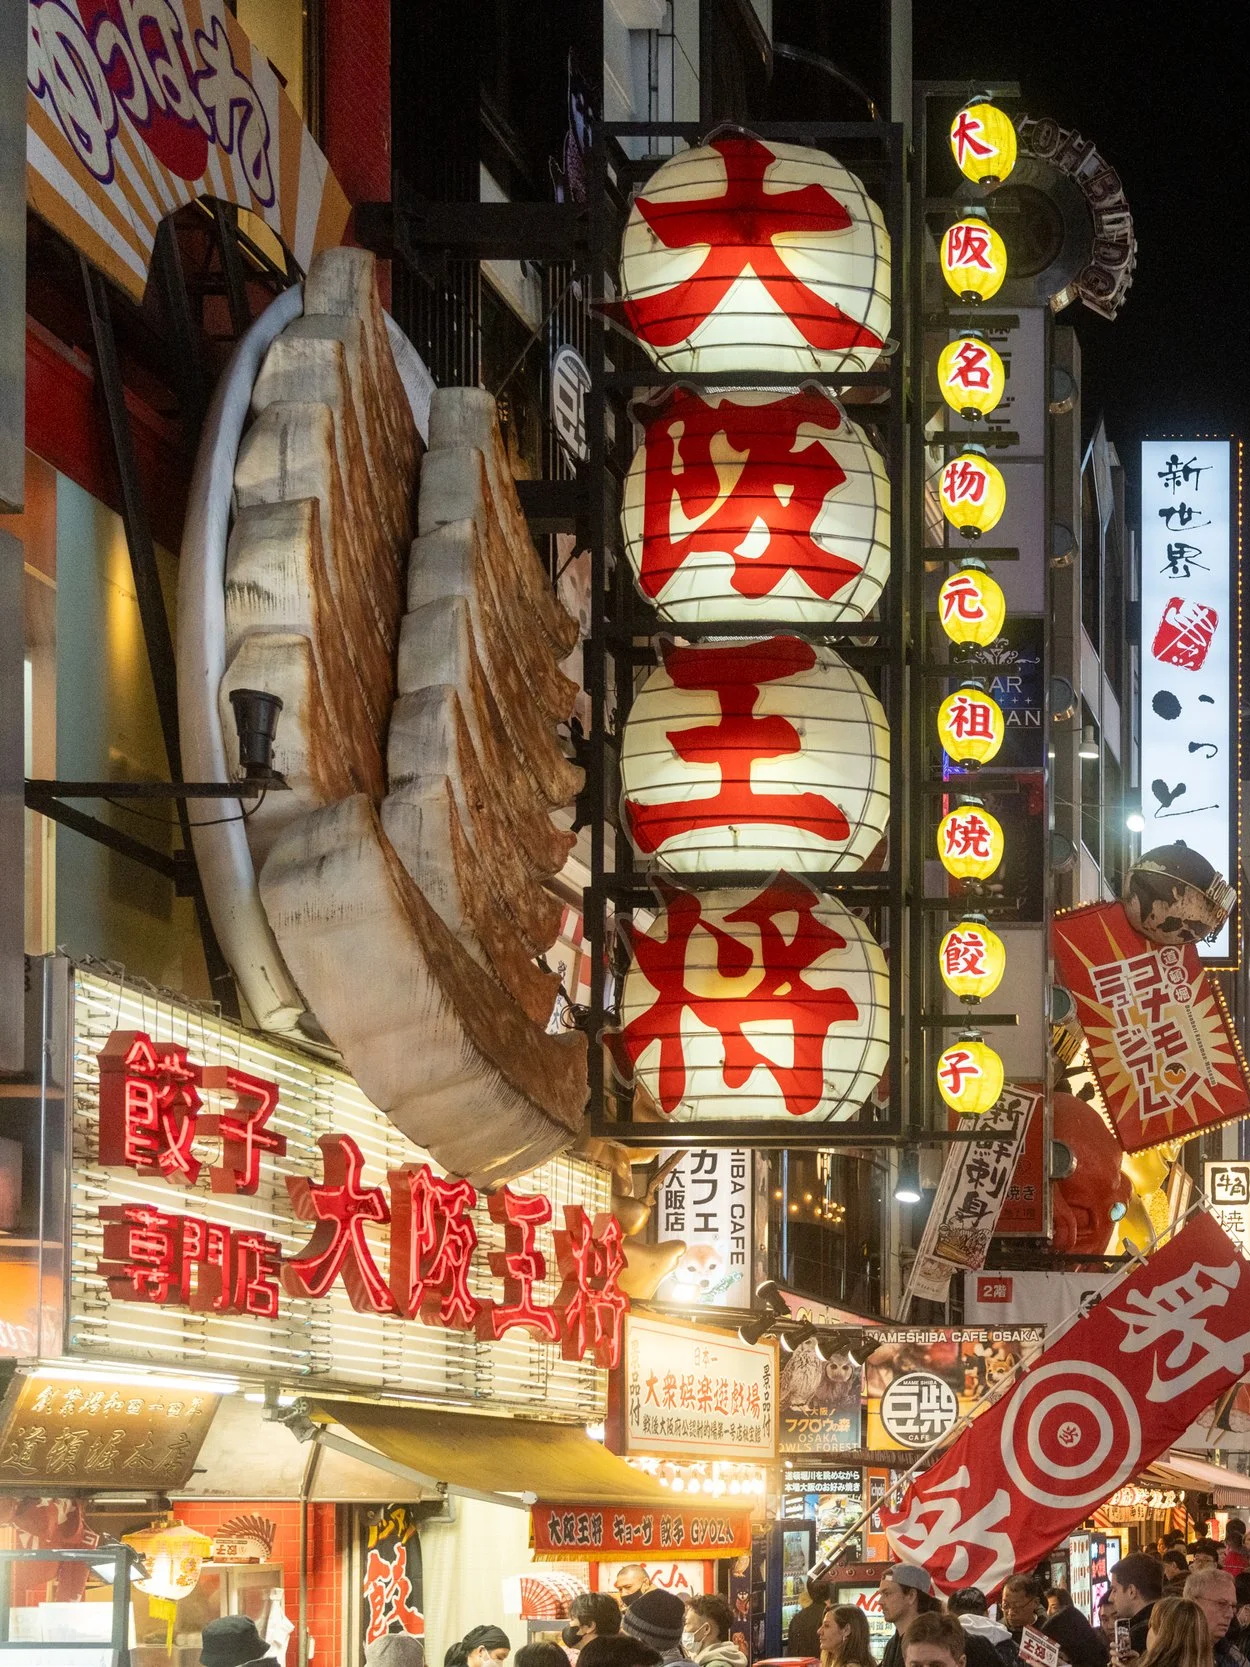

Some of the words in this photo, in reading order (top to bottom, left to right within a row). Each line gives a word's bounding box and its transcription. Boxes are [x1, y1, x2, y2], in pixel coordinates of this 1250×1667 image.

[1157, 454, 1213, 578] 新世界
[596, 135, 885, 1116] 大阪王将
[939, 115, 995, 1094] 大阪名物元祖焼餃子
[1159, 946, 1193, 1004] 道頓堀
[1088, 959, 1179, 1121] ミュージアム
[1126, 950, 1204, 1108] コナモン
[100, 1030, 286, 1196] 餃子
[664, 1168, 686, 1232] 大阪店
[1216, 1174, 1246, 1197] 牛角
[286, 1133, 629, 1369] 大阪王将
[730, 1203, 746, 1266] CAFE
[103, 1204, 283, 1319] 専門店
[982, 1284, 1008, 1299] 2階
[951, 1330, 988, 1343] CAFE
[992, 1330, 1040, 1343] OSAKA
[644, 1368, 762, 1420] 大衆娯楽遊戯場
[810, 1408, 829, 1416] 大阪
[887, 1387, 957, 1434] 豆柴
[780, 1442, 813, 1453] OWL'S
[816, 1442, 860, 1453] FOREST
[784, 1417, 851, 1433] フクロウの森
[798, 1433, 839, 1443] OSAKA
[784, 1470, 861, 1482] 道頓堀川を眺めながら
[784, 1482, 861, 1493] 本場大阪のお好み焼き
[548, 1511, 604, 1547] 大阪王将
[613, 1514, 654, 1546] ギョーザ
[660, 1514, 686, 1548] 餃子
[690, 1515, 735, 1546] GYOZA
